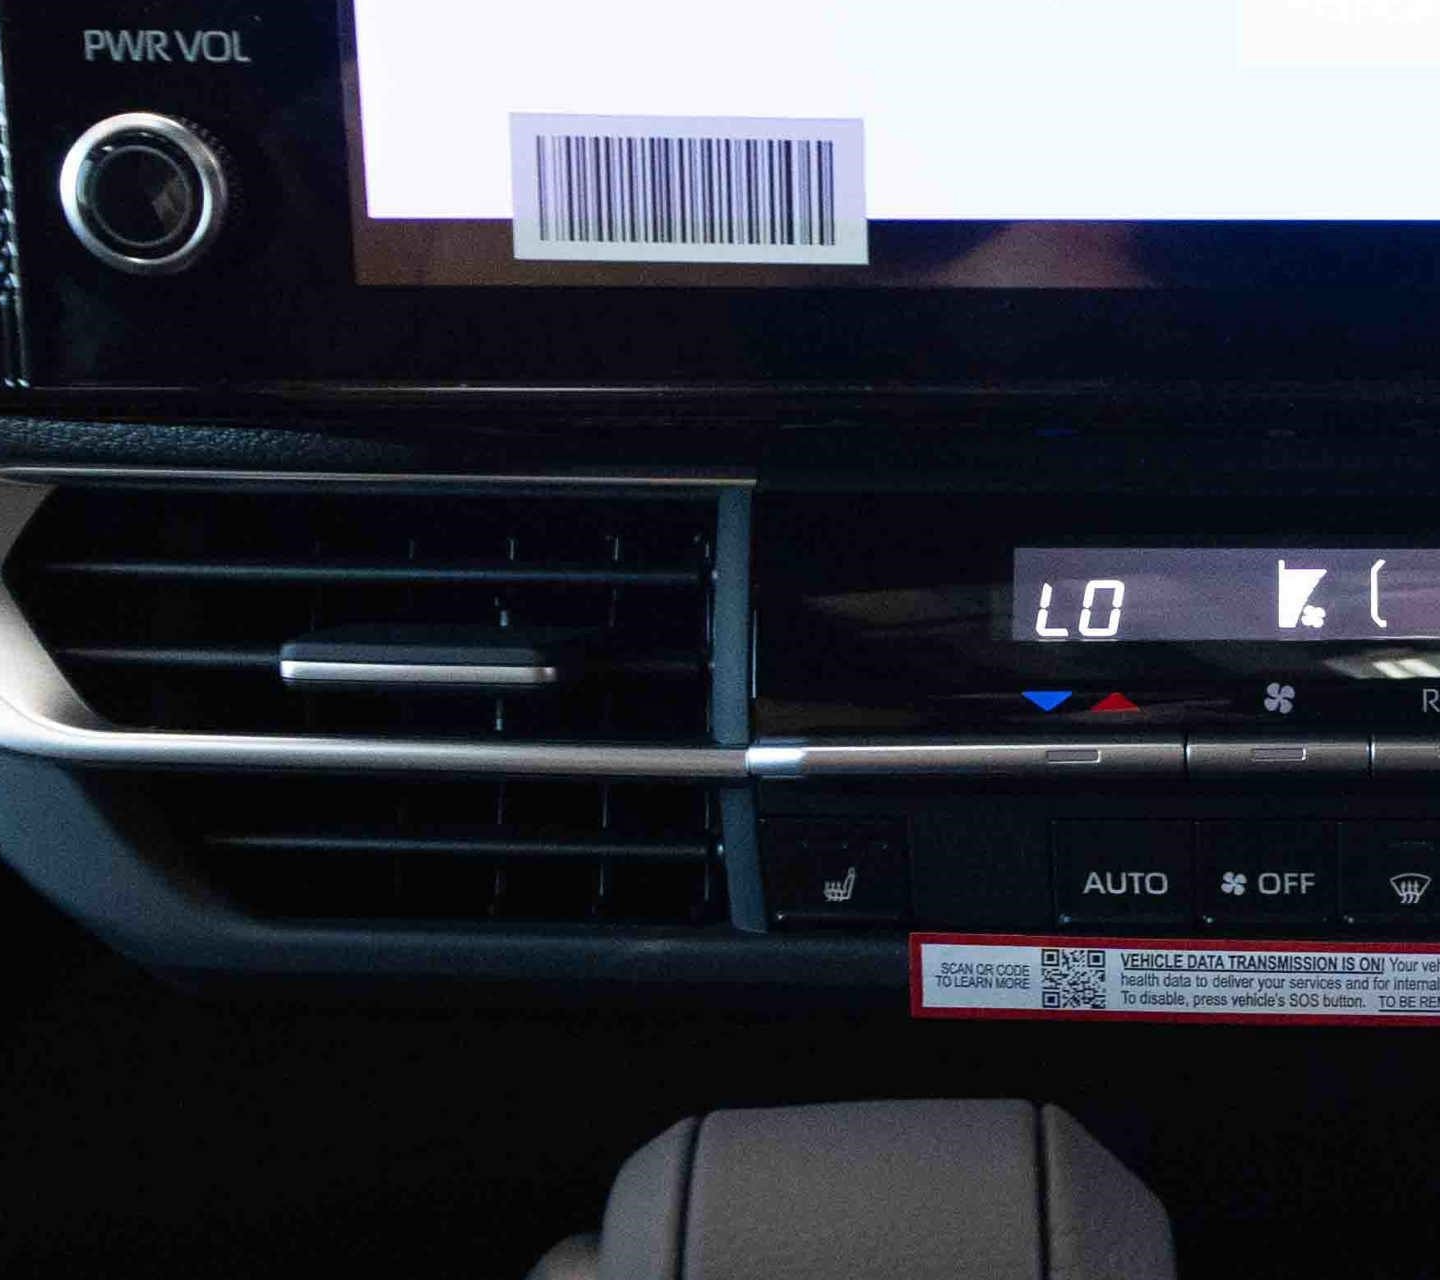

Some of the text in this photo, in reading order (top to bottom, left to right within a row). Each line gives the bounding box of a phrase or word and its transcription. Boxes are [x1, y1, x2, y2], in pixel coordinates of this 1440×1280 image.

[83, 29, 251, 63] PWR VOL
[1035, 579, 1126, 637] LO
[1083, 871, 1168, 895] AUTO
[1258, 872, 1315, 895] OFF
[941, 962, 972, 975] SCAN
[996, 964, 1030, 977] CODE
[1121, 953, 1184, 969] VEHICLE
[1187, 954, 1224, 969] DATA
[1228, 955, 1337, 971] TRANSMISSION
[1342, 956, 1355, 971] IS
[1360, 957, 1385, 972] ON!
[1389, 957, 1418, 971] Your
[936, 975, 1030, 990] TO LEARN MORE
[1121, 972, 1159, 987] health
[1163, 973, 1191, 988] data
[1196, 974, 1208, 988] to
[1213, 974, 1254, 988] deliver
[1257, 978, 1285, 992] your
[1289, 976, 1342, 989] services
[1345, 977, 1369, 990] and
[1373, 976, 1390, 990] for
[1393, 977, 1440, 991] internal
[1121, 991, 1136, 1005] To
[1140, 991, 1189, 1007] disable,
[1193, 994, 1228, 1008] press
[1231, 992, 1285, 1007] vehicle's
[1289, 993, 1320, 1008] SOS
[1323, 993, 1366, 1008] button.
[1379, 995, 1395, 1008] TO
[1399, 996, 1416, 1009] BE
